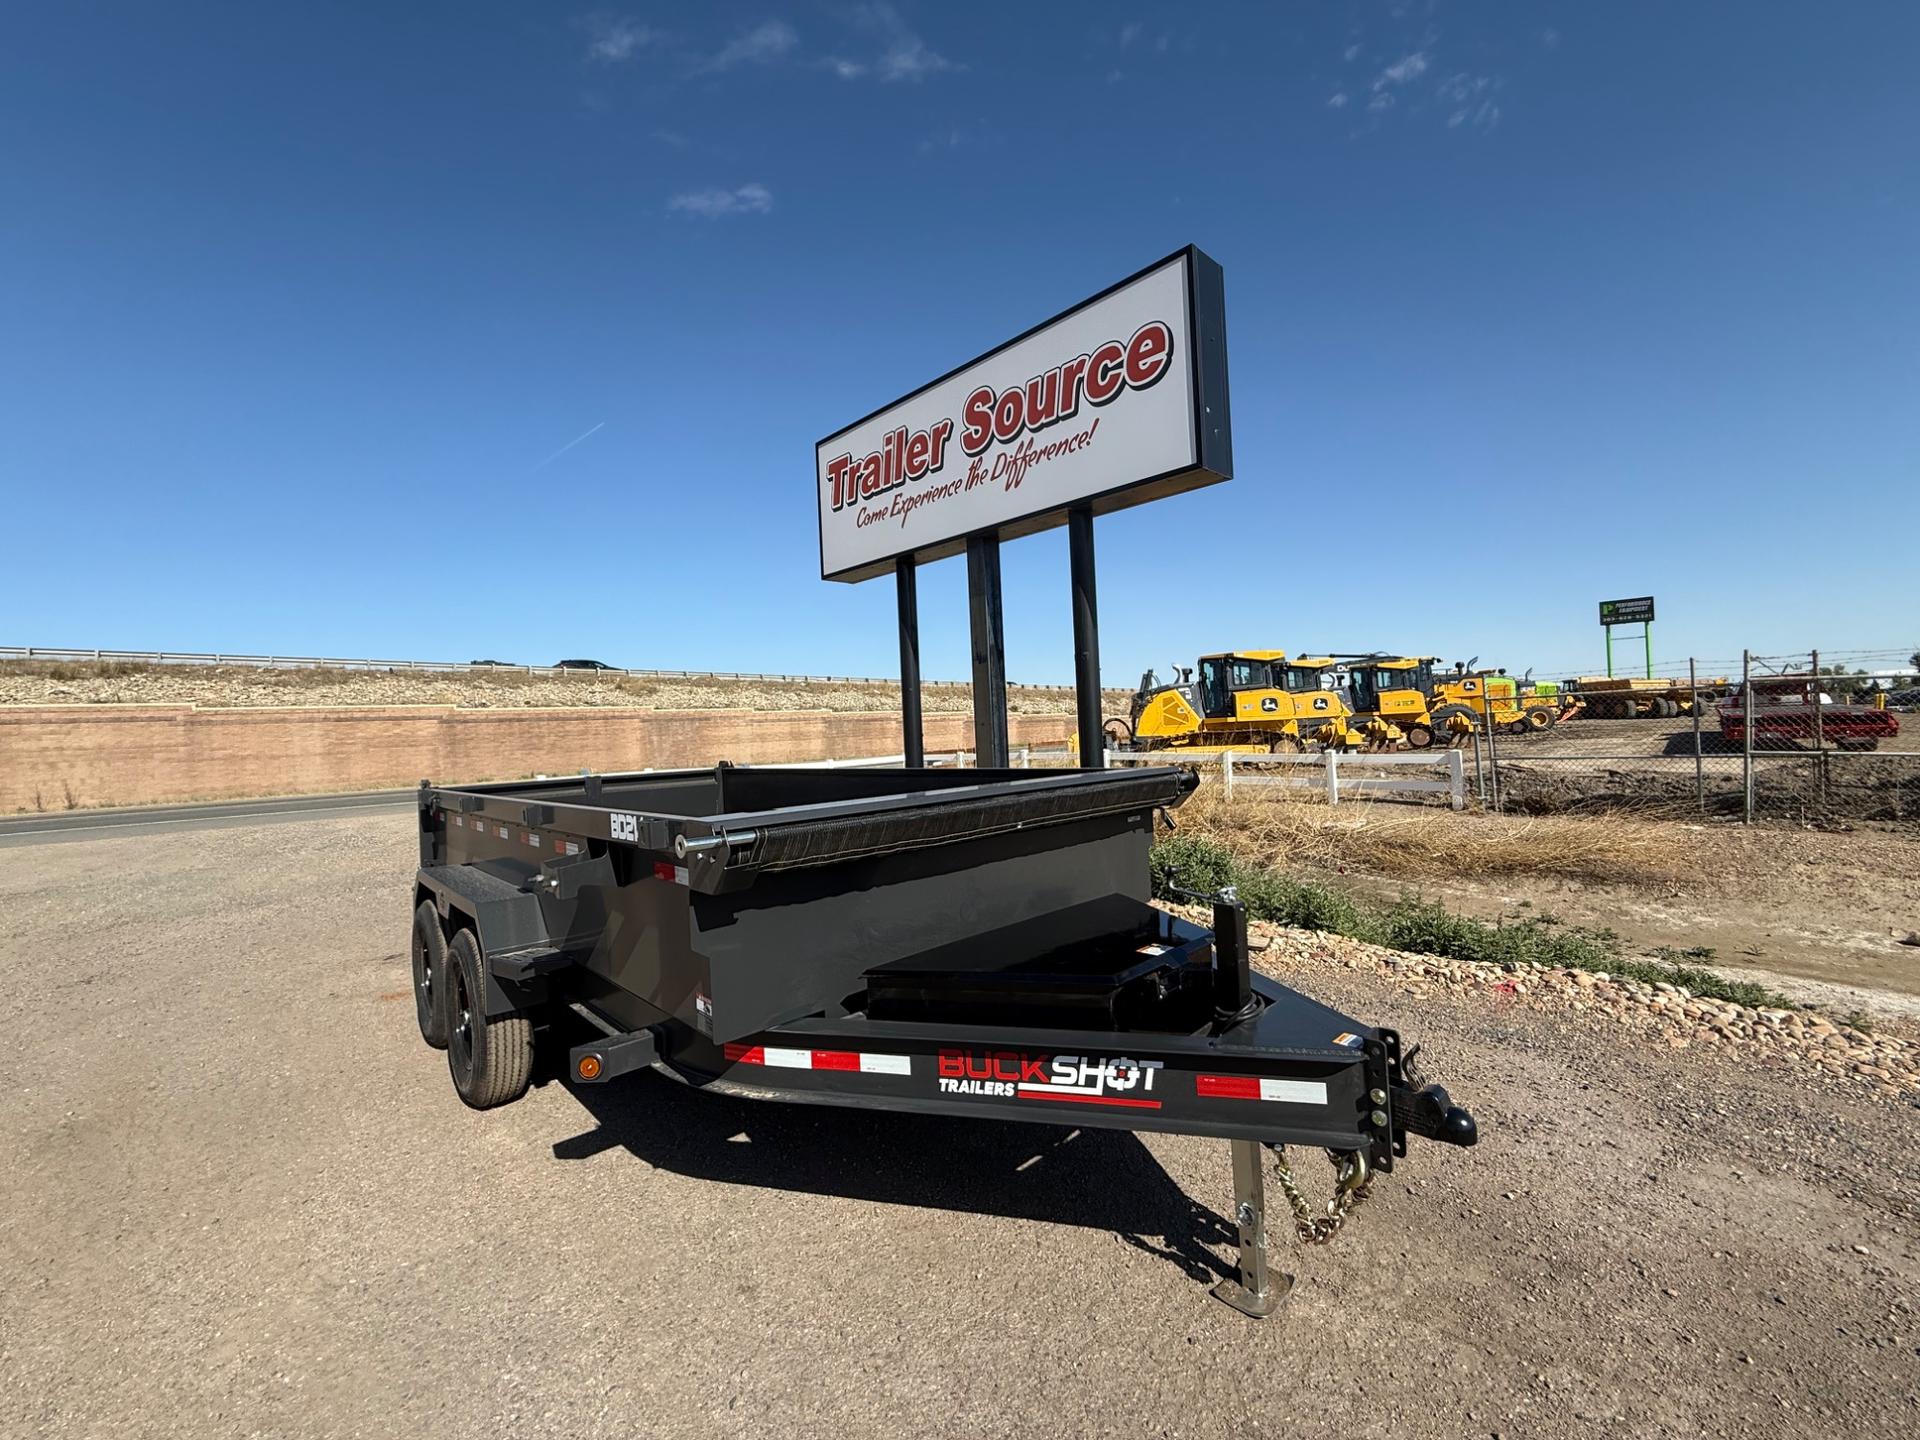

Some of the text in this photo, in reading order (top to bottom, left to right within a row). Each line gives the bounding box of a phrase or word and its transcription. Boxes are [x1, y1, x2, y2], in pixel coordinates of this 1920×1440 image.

[826, 320, 1174, 512] Trailer Source
[856, 417, 1101, 529] Come Experience the Difference!
[938, 1079, 1015, 1097] TRAILERS
